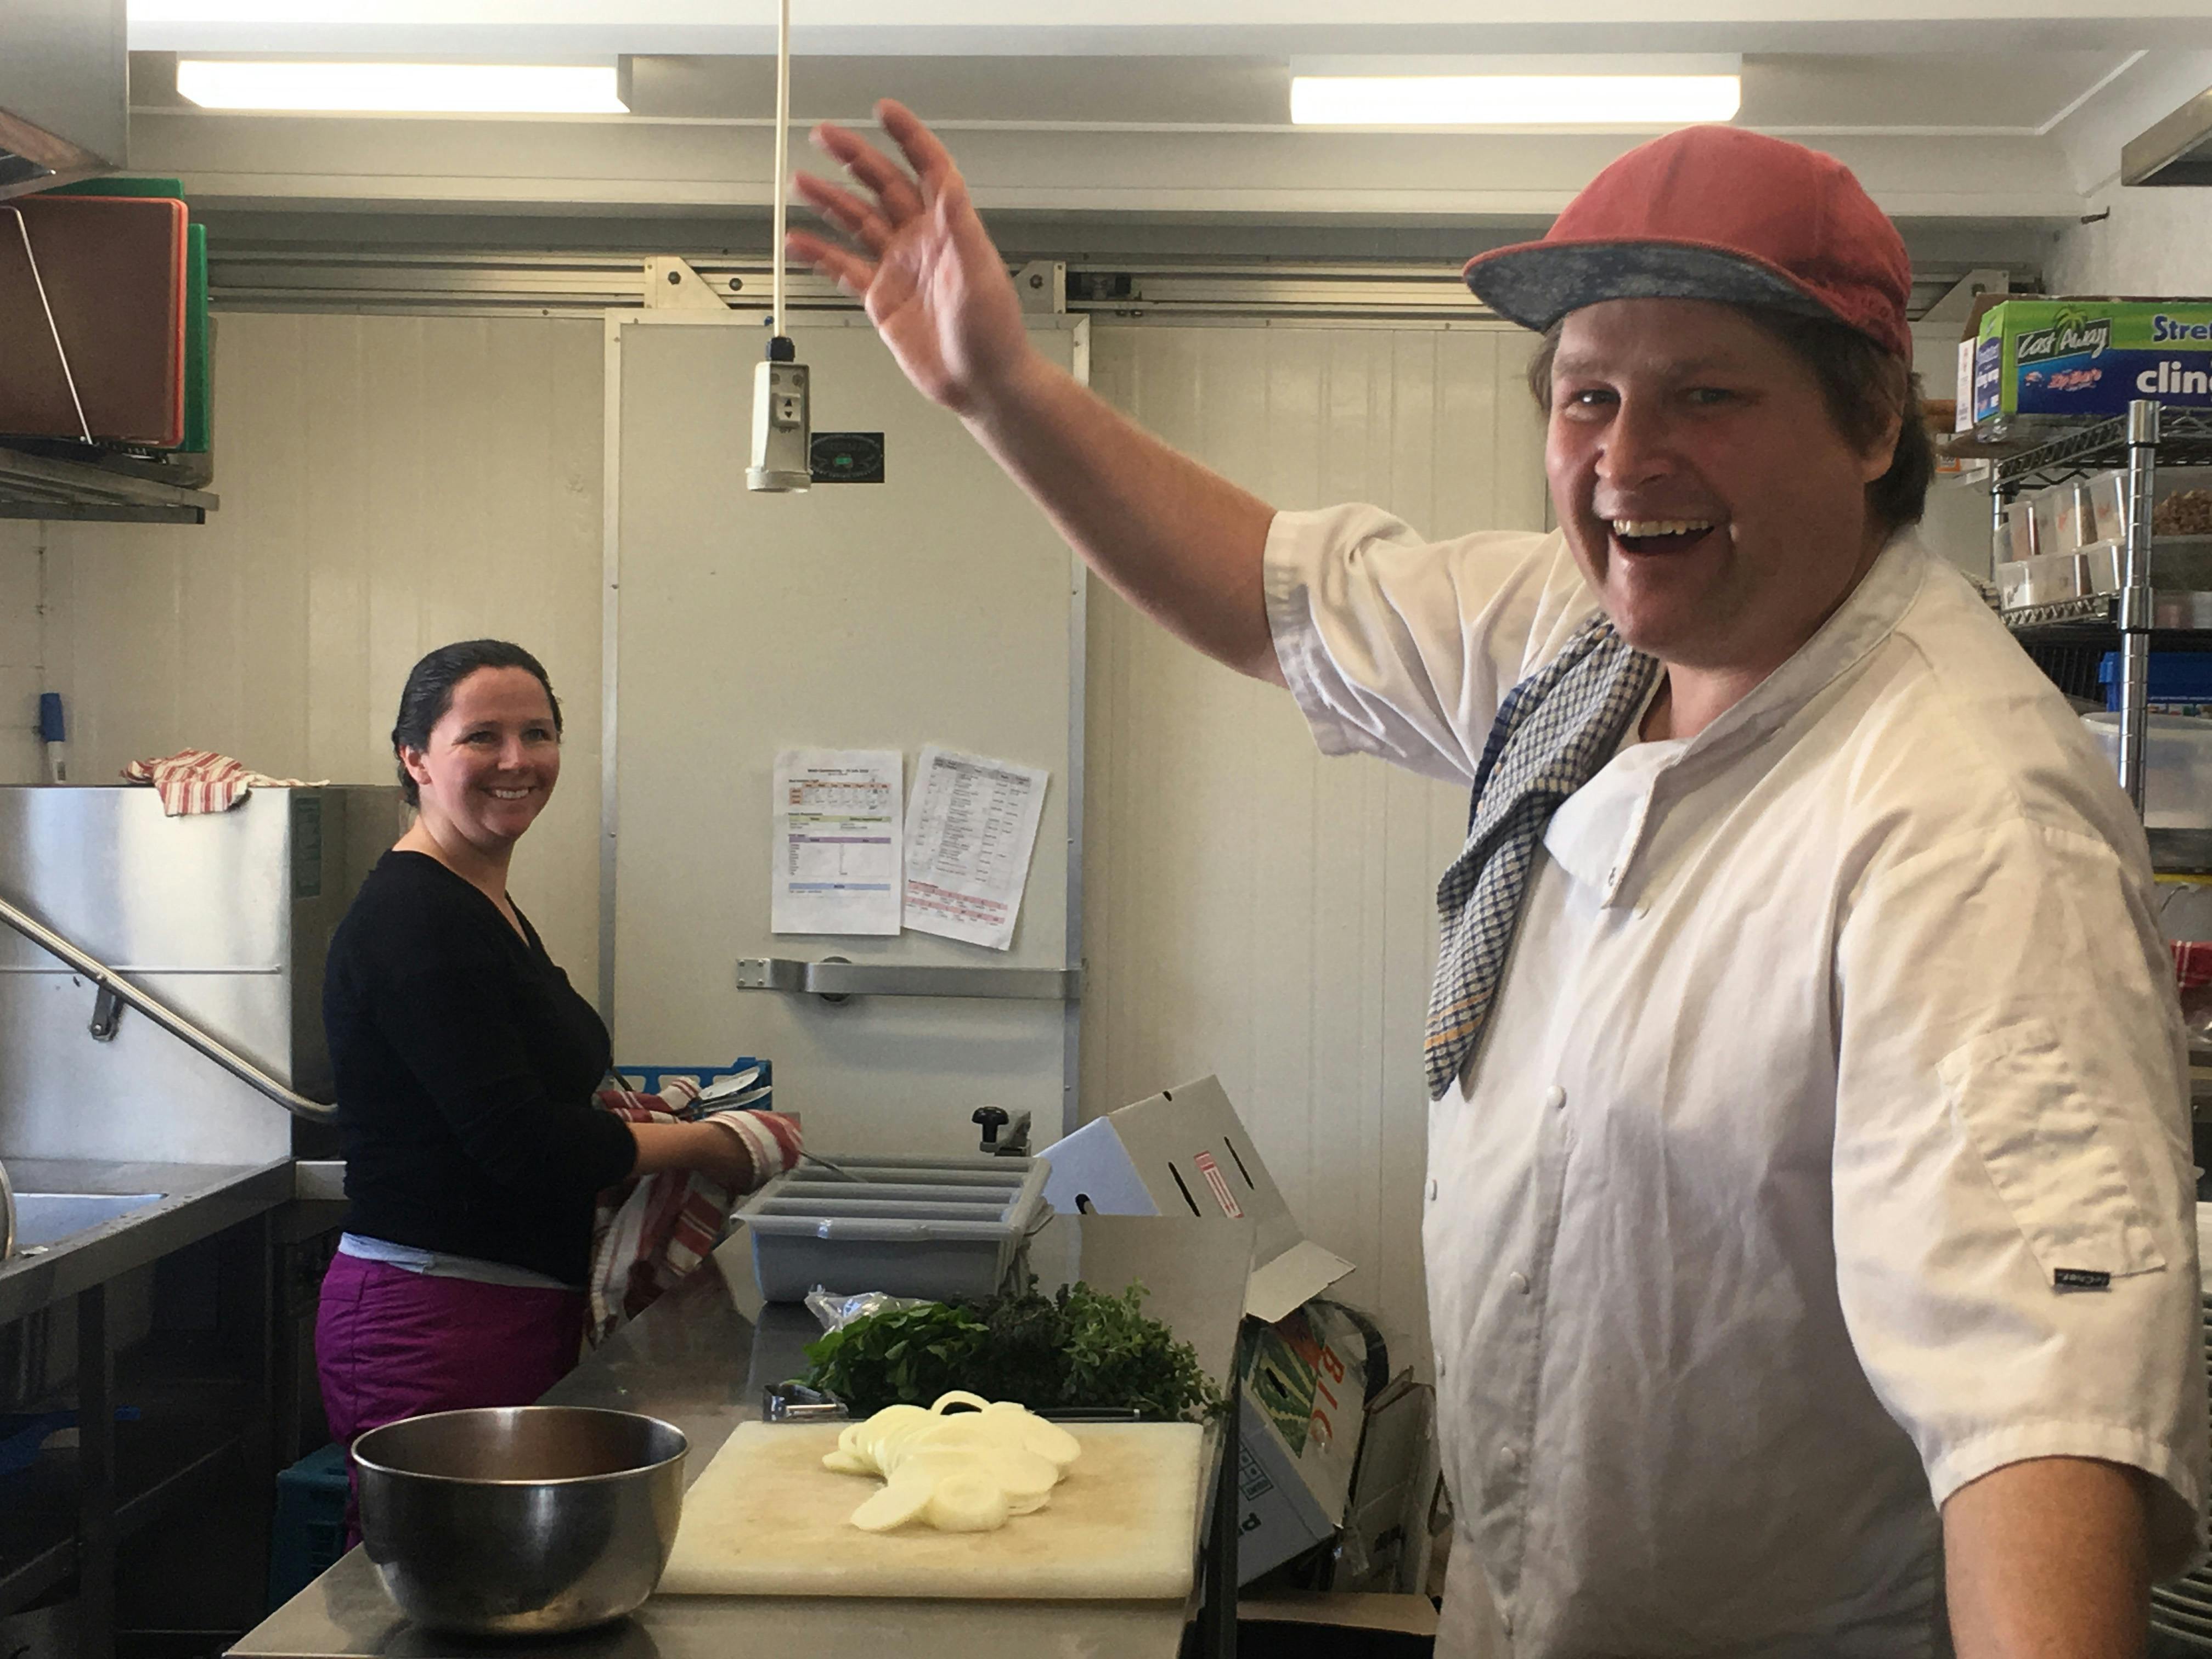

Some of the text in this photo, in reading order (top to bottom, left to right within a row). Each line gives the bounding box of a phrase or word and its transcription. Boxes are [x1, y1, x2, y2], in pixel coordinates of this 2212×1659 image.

[2018, 328, 2108, 359] Cast Away
[2152, 314, 2212, 342] Stre
[2136, 360, 2212, 394] clin
